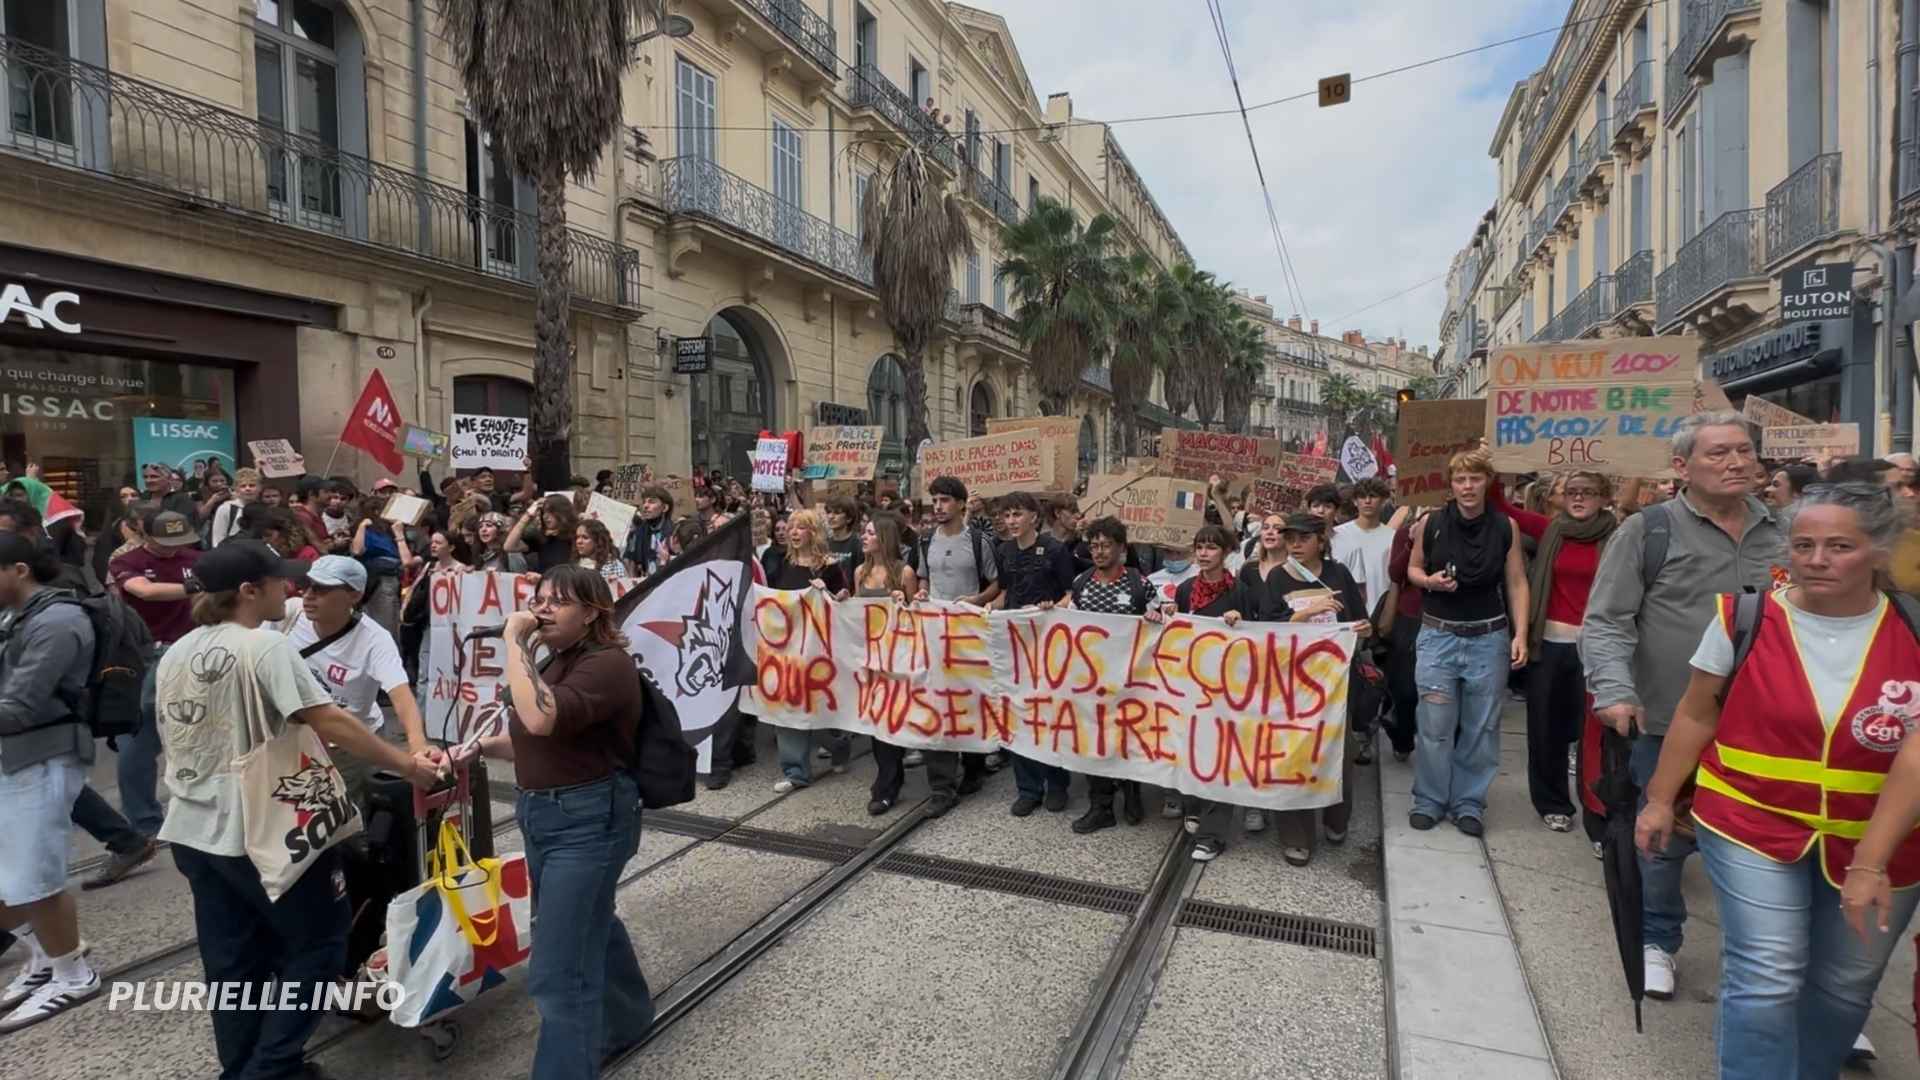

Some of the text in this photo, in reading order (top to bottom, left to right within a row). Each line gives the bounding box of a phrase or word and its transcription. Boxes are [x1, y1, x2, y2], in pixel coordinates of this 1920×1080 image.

[1324, 83, 1344, 99] 10
[1784, 291, 1850, 307] FUTON
[1784, 306, 1849, 319] BOUTIQUE
[7, 368, 144, 388] qui change la vue
[1496, 352, 1542, 386] ON
[1551, 351, 1607, 380] VEUT
[1496, 386, 1673, 416] DE NOTRE BAC
[151, 423, 219, 439] LISSAC
[455, 417, 527, 436] ME SHOOTEZ
[1496, 414, 1537, 448] PAS
[1536, 416, 1609, 440] 100%
[1616, 414, 1648, 437] DE
[809, 440, 833, 452] NOUS
[1177, 429, 1258, 457] MACRON
[926, 450, 945, 464] PAS
[968, 445, 1007, 460] FACHOS
[1008, 457, 1026, 469] PAS
[1029, 455, 1041, 467] DE
[432, 574, 464, 615] ON
[478, 572, 503, 616] A
[752, 593, 1347, 720] ON RATE NOS LEÇONS
[757, 655, 839, 714] OUR
[853, 670, 943, 738] VOUS
[934, 687, 1016, 743] EN
[1023, 691, 1180, 762] FAIRE
[1865, 724, 1901, 742] cgt
